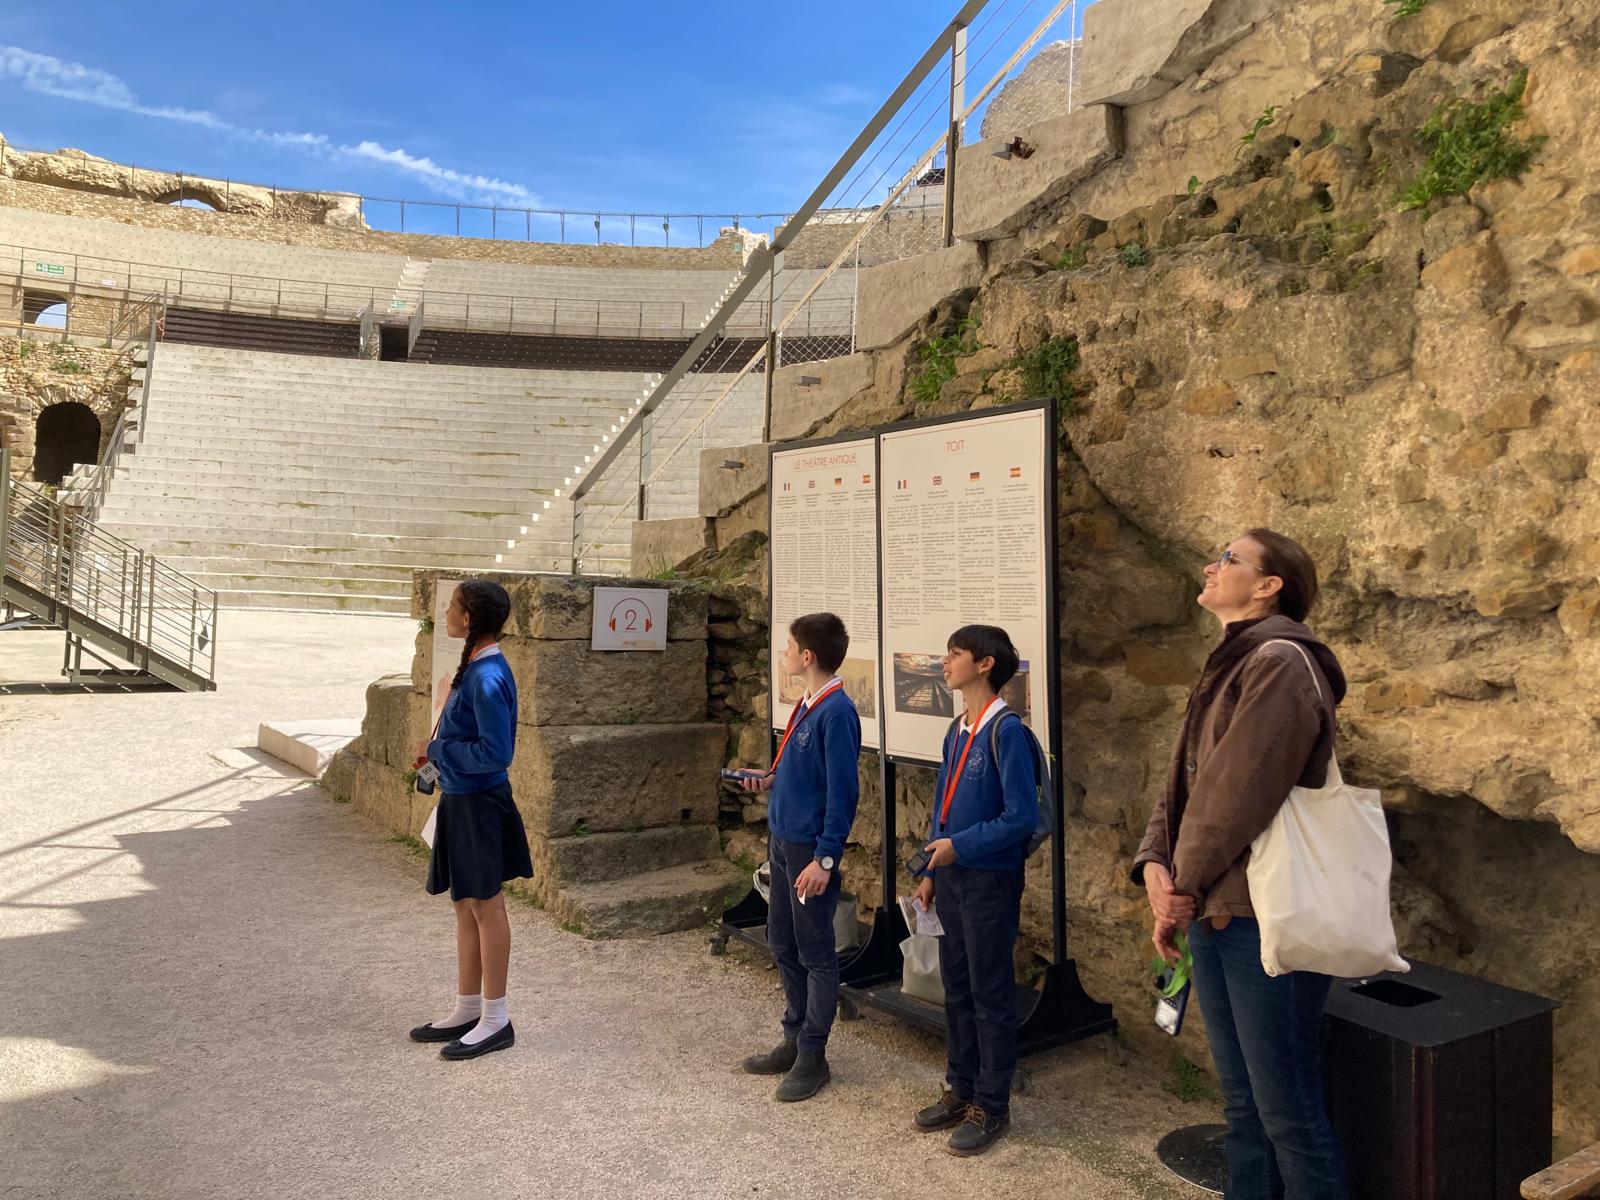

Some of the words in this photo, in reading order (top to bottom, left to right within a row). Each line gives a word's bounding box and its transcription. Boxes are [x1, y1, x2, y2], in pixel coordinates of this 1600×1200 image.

[945, 439, 966, 452] TOIT
[793, 460, 801, 470] LE
[829, 453, 857, 464] ANTIQUE
[625, 609, 637, 630] 2
